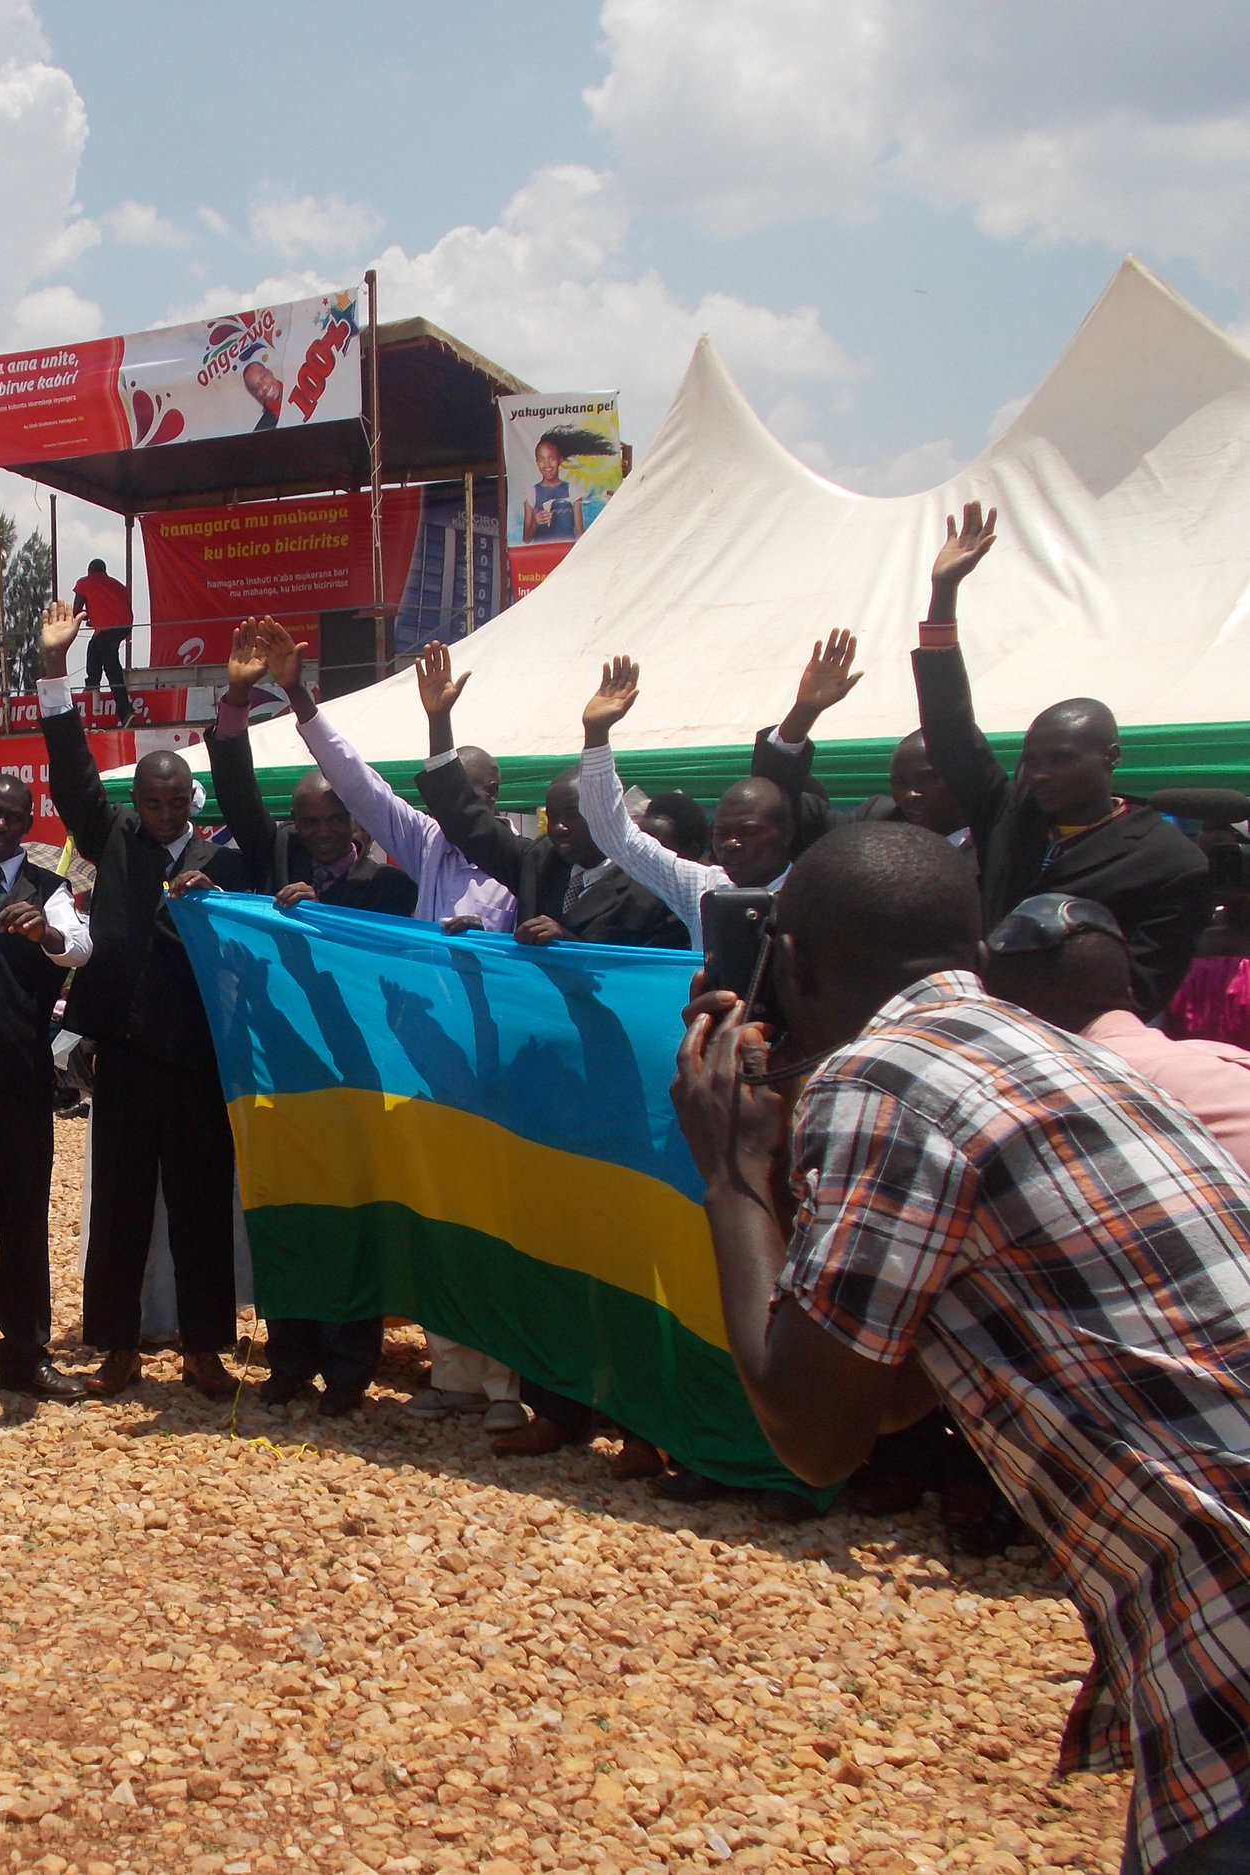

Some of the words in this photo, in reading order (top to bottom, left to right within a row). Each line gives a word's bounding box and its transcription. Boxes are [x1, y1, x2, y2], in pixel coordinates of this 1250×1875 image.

[197, 310, 276, 387] ongezwa
[7, 358, 38, 374] ama
[41, 351, 79, 369] unite,
[37, 370, 79, 390] kabiri
[509, 403, 594, 421] yakugurukana
[596, 400, 615, 414] pe!
[160, 518, 240, 537] hamagara
[244, 514, 269, 529] mu
[273, 507, 349, 527] mahanga
[204, 546, 223, 561] ku
[227, 542, 270, 559] biciro
[275, 532, 350, 554] biciriritse
